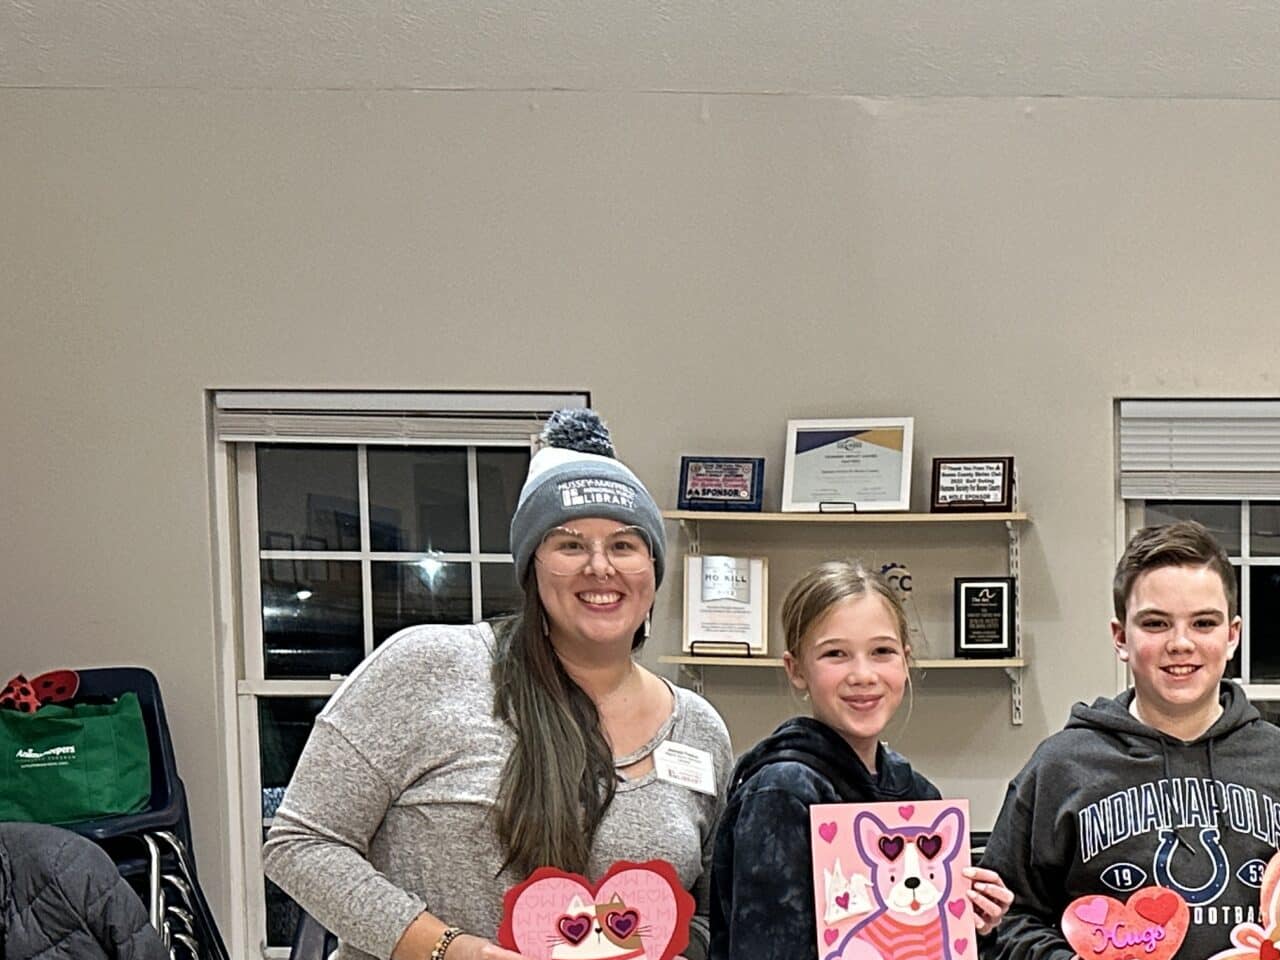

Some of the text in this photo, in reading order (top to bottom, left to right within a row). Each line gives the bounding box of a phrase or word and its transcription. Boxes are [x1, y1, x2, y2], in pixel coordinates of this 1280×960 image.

[583, 493, 635, 509] LIBRARY
[701, 488, 739, 497] SPONSOR
[1113, 868, 1132, 887] 19
[1193, 905, 1263, 925] OOTBA
[1092, 923, 1166, 954] Hugs
